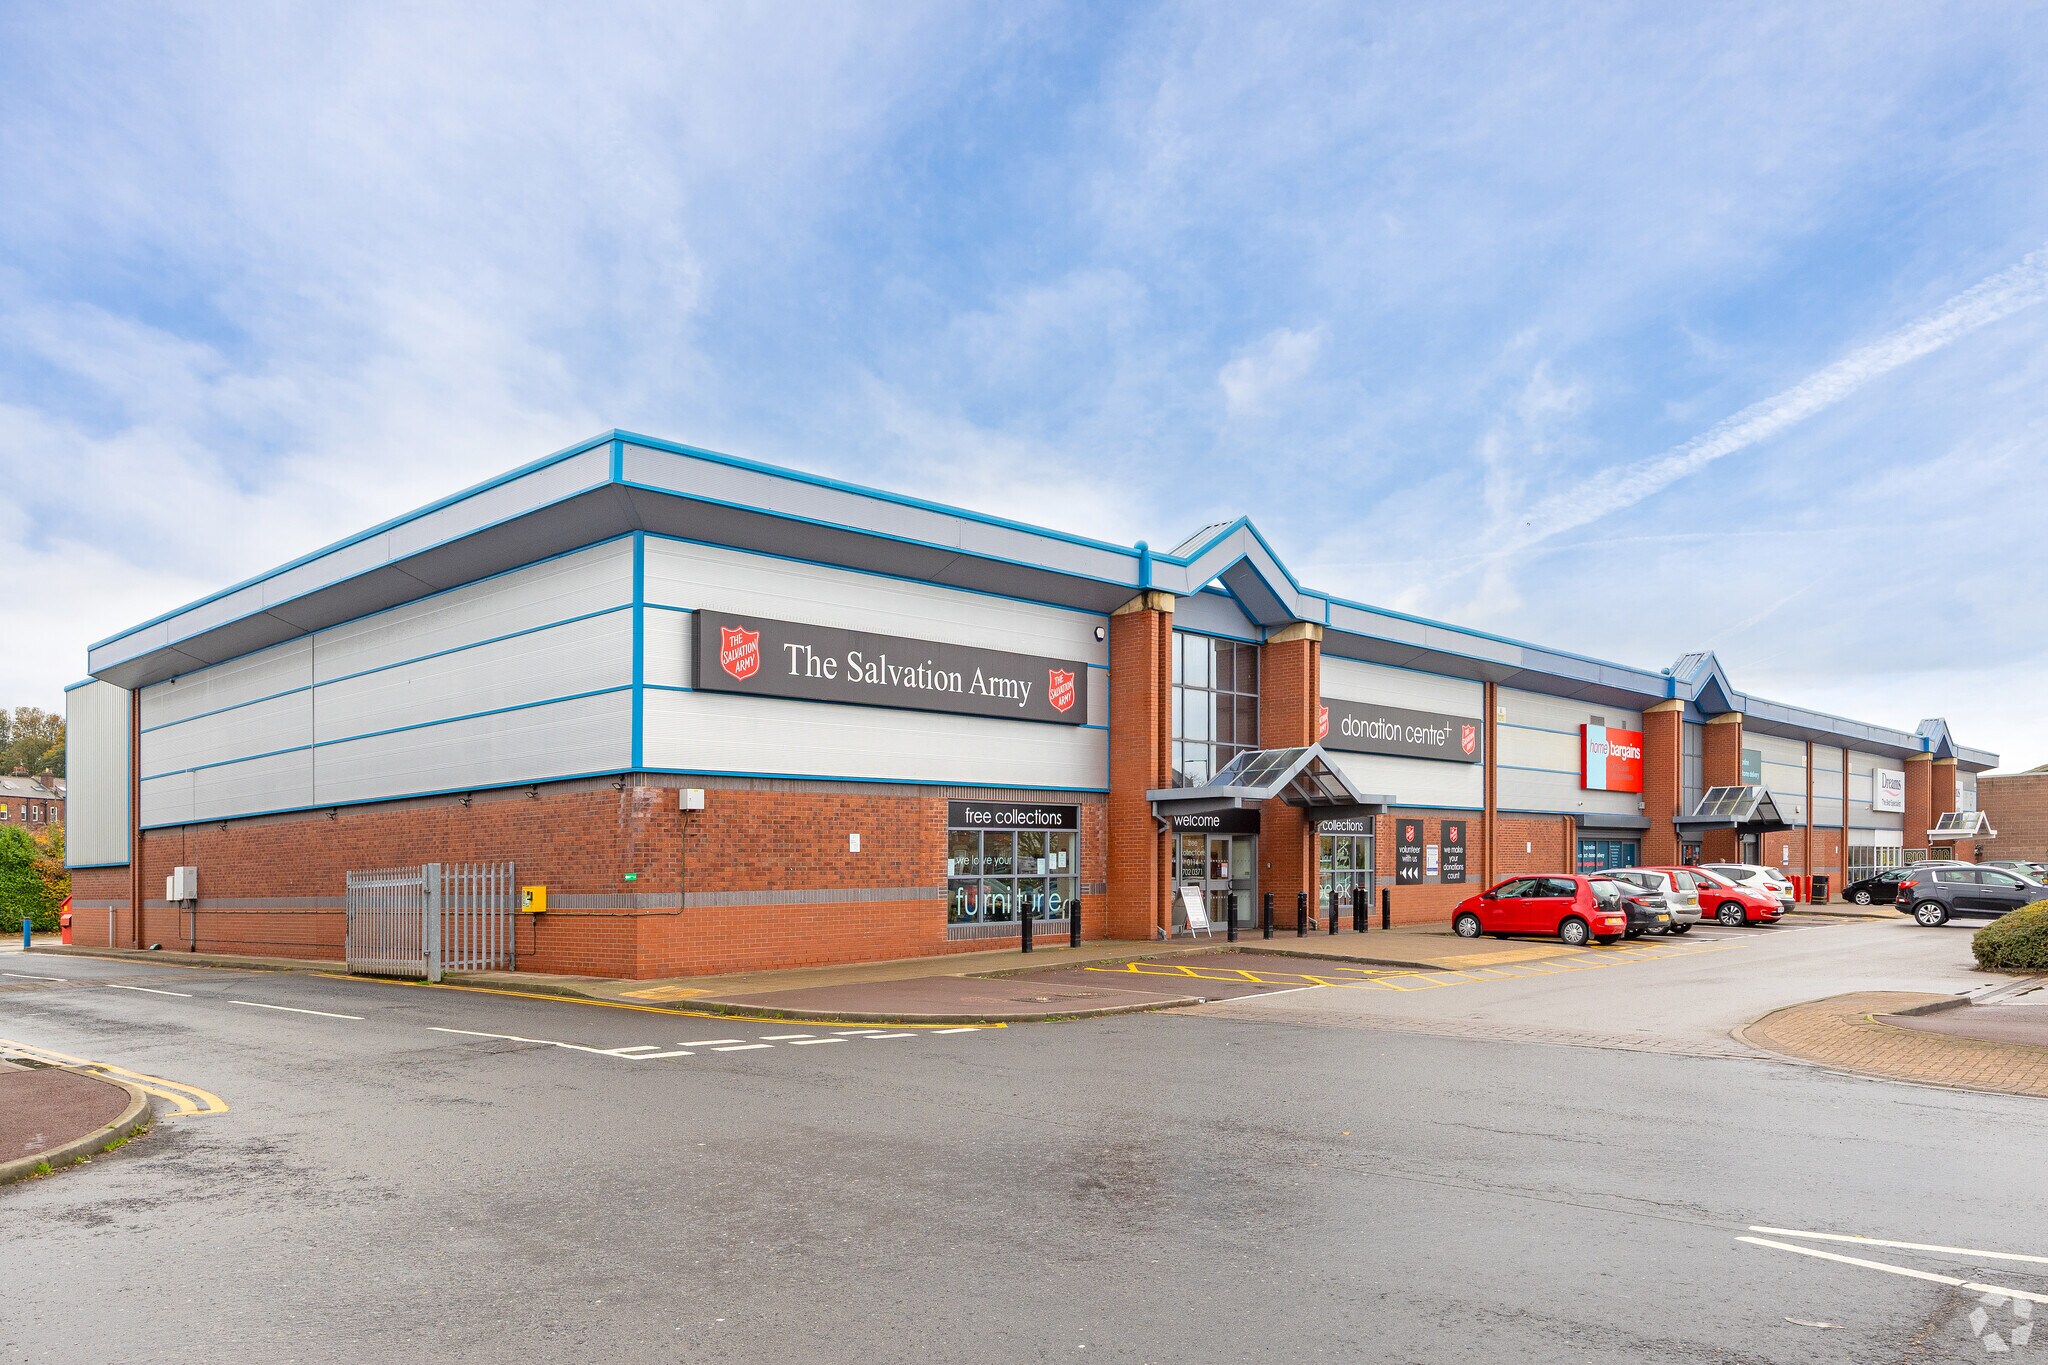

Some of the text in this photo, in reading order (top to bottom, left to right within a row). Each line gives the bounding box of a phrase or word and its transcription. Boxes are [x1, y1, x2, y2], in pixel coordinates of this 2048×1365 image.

[729, 634, 743, 647] THE
[723, 639, 757, 664] SALVATION
[735, 654, 755, 673] ARMY
[783, 643, 1032, 708] The Salvation Army
[1341, 714, 1402, 741] donation
[1590, 739, 1641, 761] home bargains
[1882, 772, 1901, 791] Dreams
[965, 807, 1062, 825] free collections
[1173, 815, 1220, 827] welcome
[1322, 819, 1364, 832] collections
[1399, 845, 1421, 854] volunteer
[1451, 846, 1464, 854] make
[956, 854, 1013, 867] we love your
[1449, 855, 1459, 864] your
[1442, 863, 1465, 871] donations
[1447, 872, 1460, 880] count
[955, 886, 1062, 916] furniture
